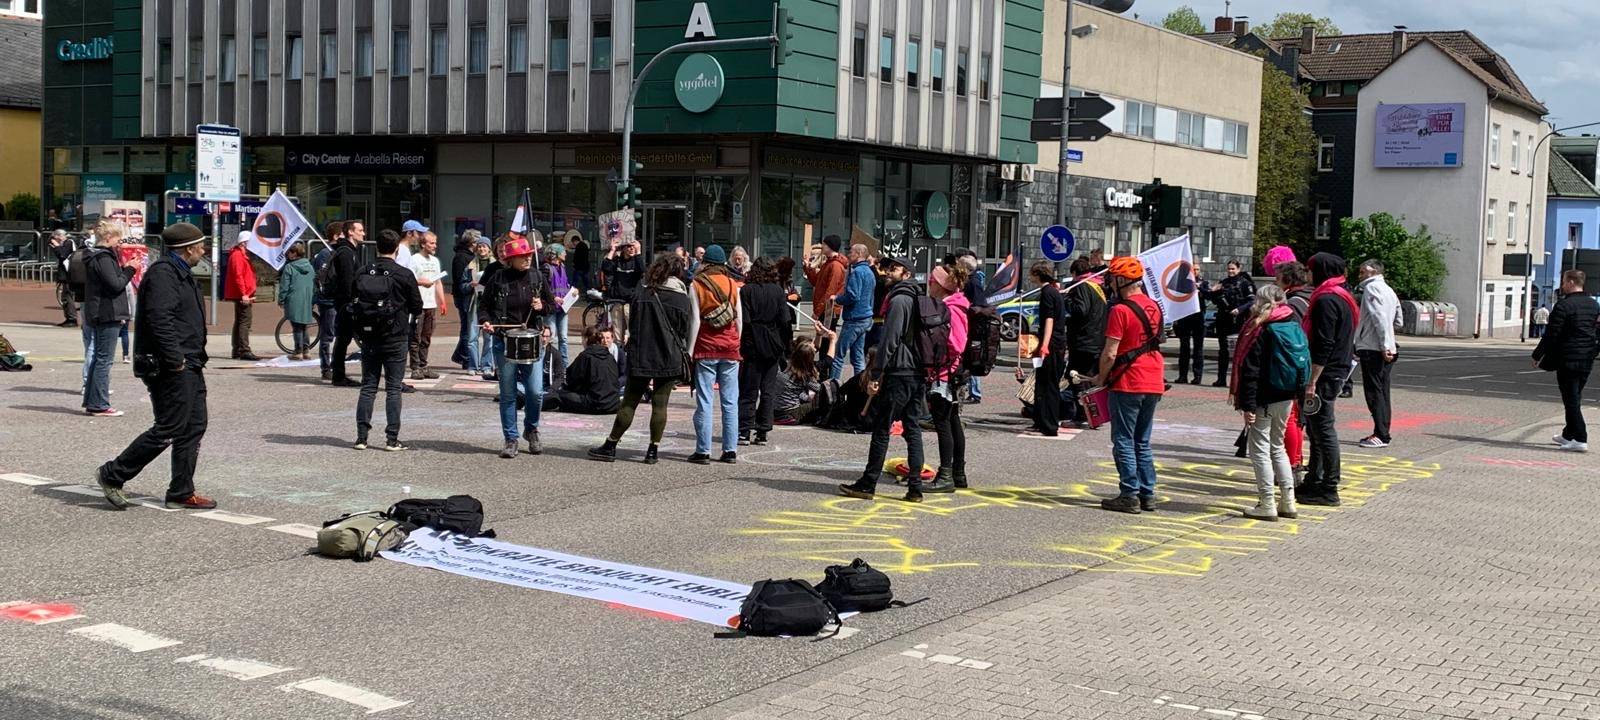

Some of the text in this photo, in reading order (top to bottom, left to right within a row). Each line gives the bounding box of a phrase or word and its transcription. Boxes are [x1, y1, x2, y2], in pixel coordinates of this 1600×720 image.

[684, 2, 717, 38] A
[679, 75, 718, 91] yggotel
[302, 152, 425, 166] City Center Arabella Reisen
[553, 561, 681, 587] BRAUCHT
[671, 581, 749, 601] EHRLI
